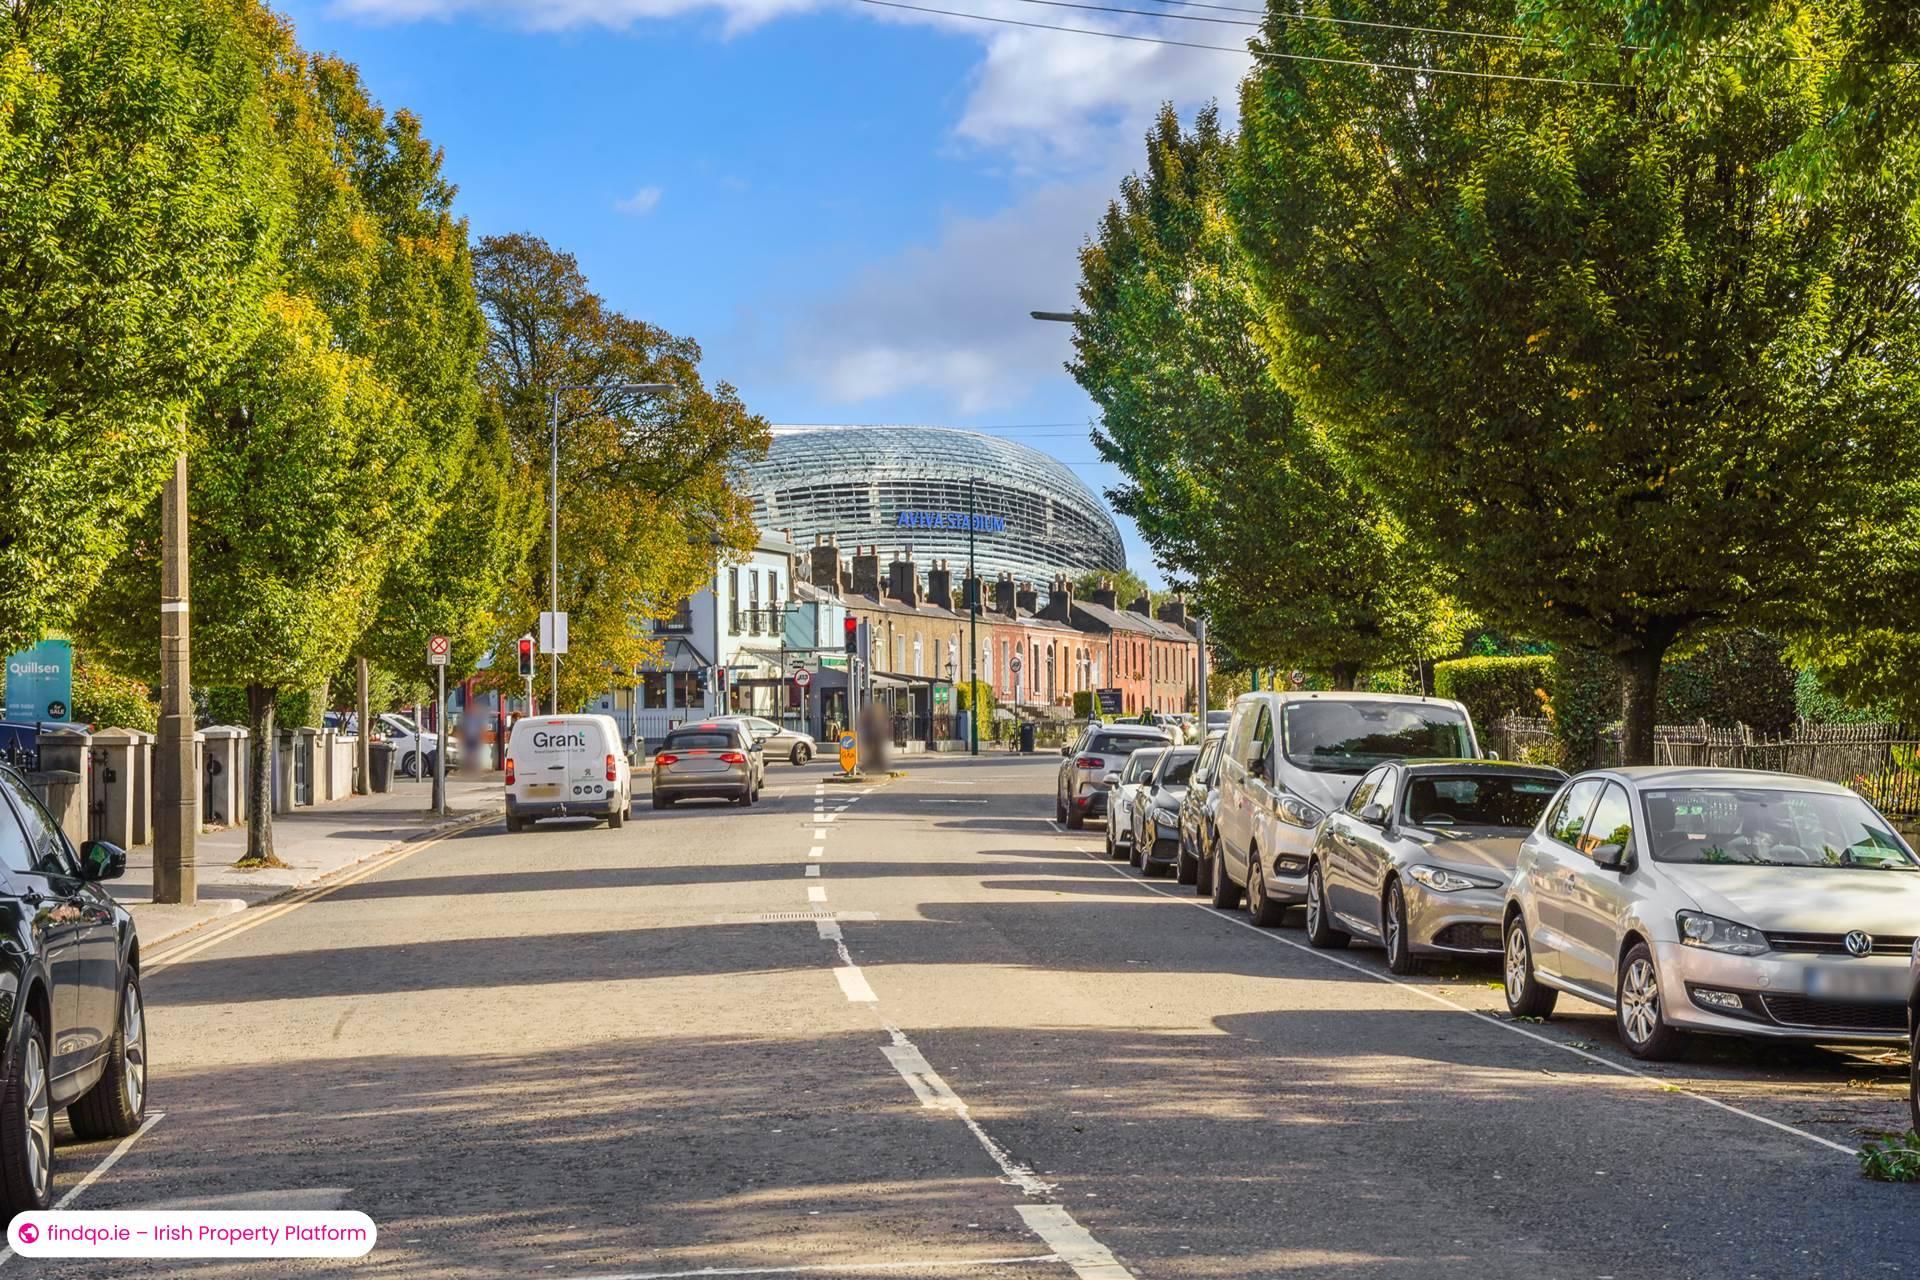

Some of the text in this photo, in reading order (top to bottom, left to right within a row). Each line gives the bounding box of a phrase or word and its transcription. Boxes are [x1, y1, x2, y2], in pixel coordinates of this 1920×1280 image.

[898, 511, 1004, 531] AVIVA STADIUM
[10, 662, 59, 676] Quillsen
[533, 731, 585, 747] Grant
